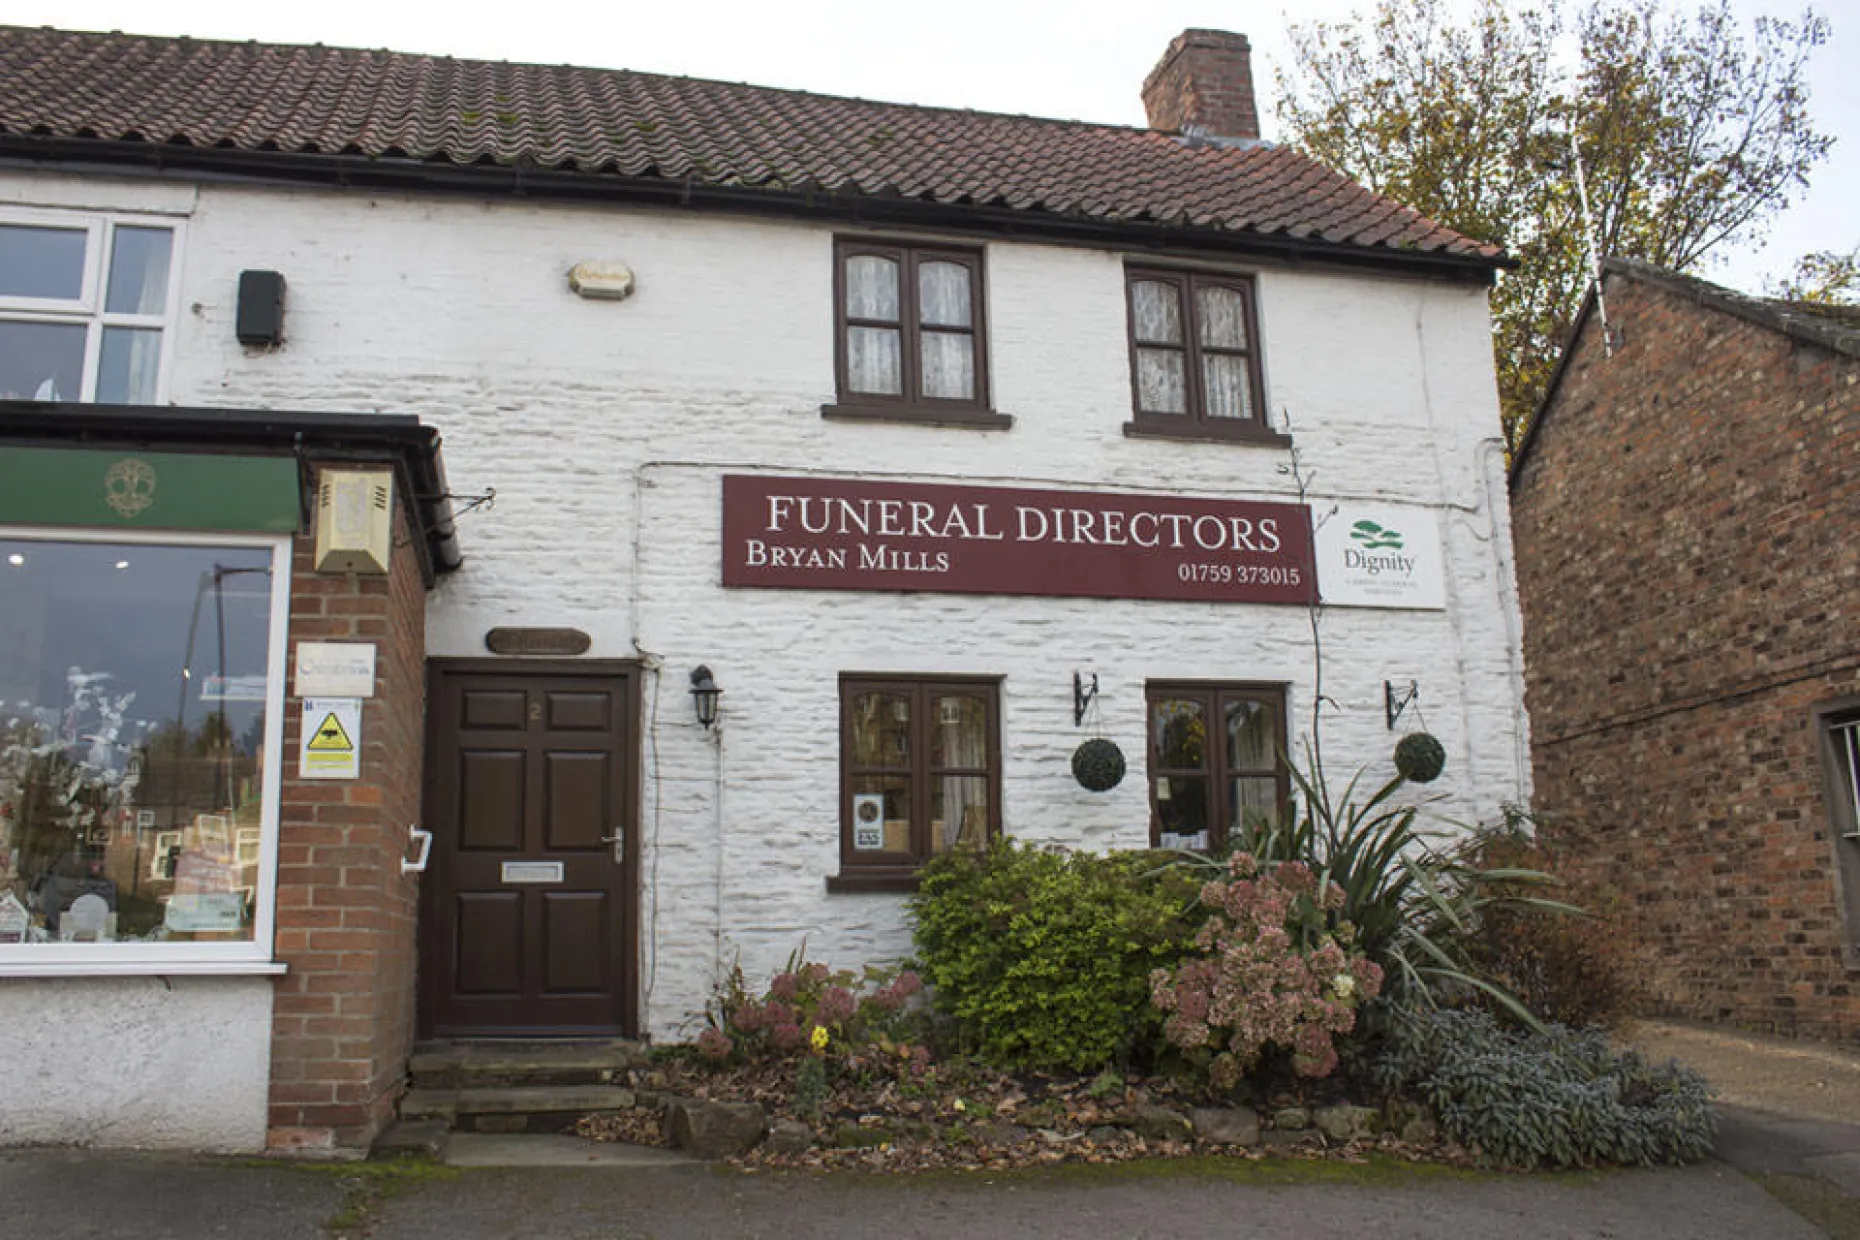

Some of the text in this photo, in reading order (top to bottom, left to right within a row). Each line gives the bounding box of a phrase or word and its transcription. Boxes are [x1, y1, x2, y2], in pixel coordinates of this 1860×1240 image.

[765, 494, 1281, 553] FUNERAL DIRECTORS
[745, 538, 950, 573] BRYAN MILLS
[1344, 547, 1415, 578] Dignity
[1177, 562, 1301, 585] 01759 373015
[530, 702, 542, 720] 2
